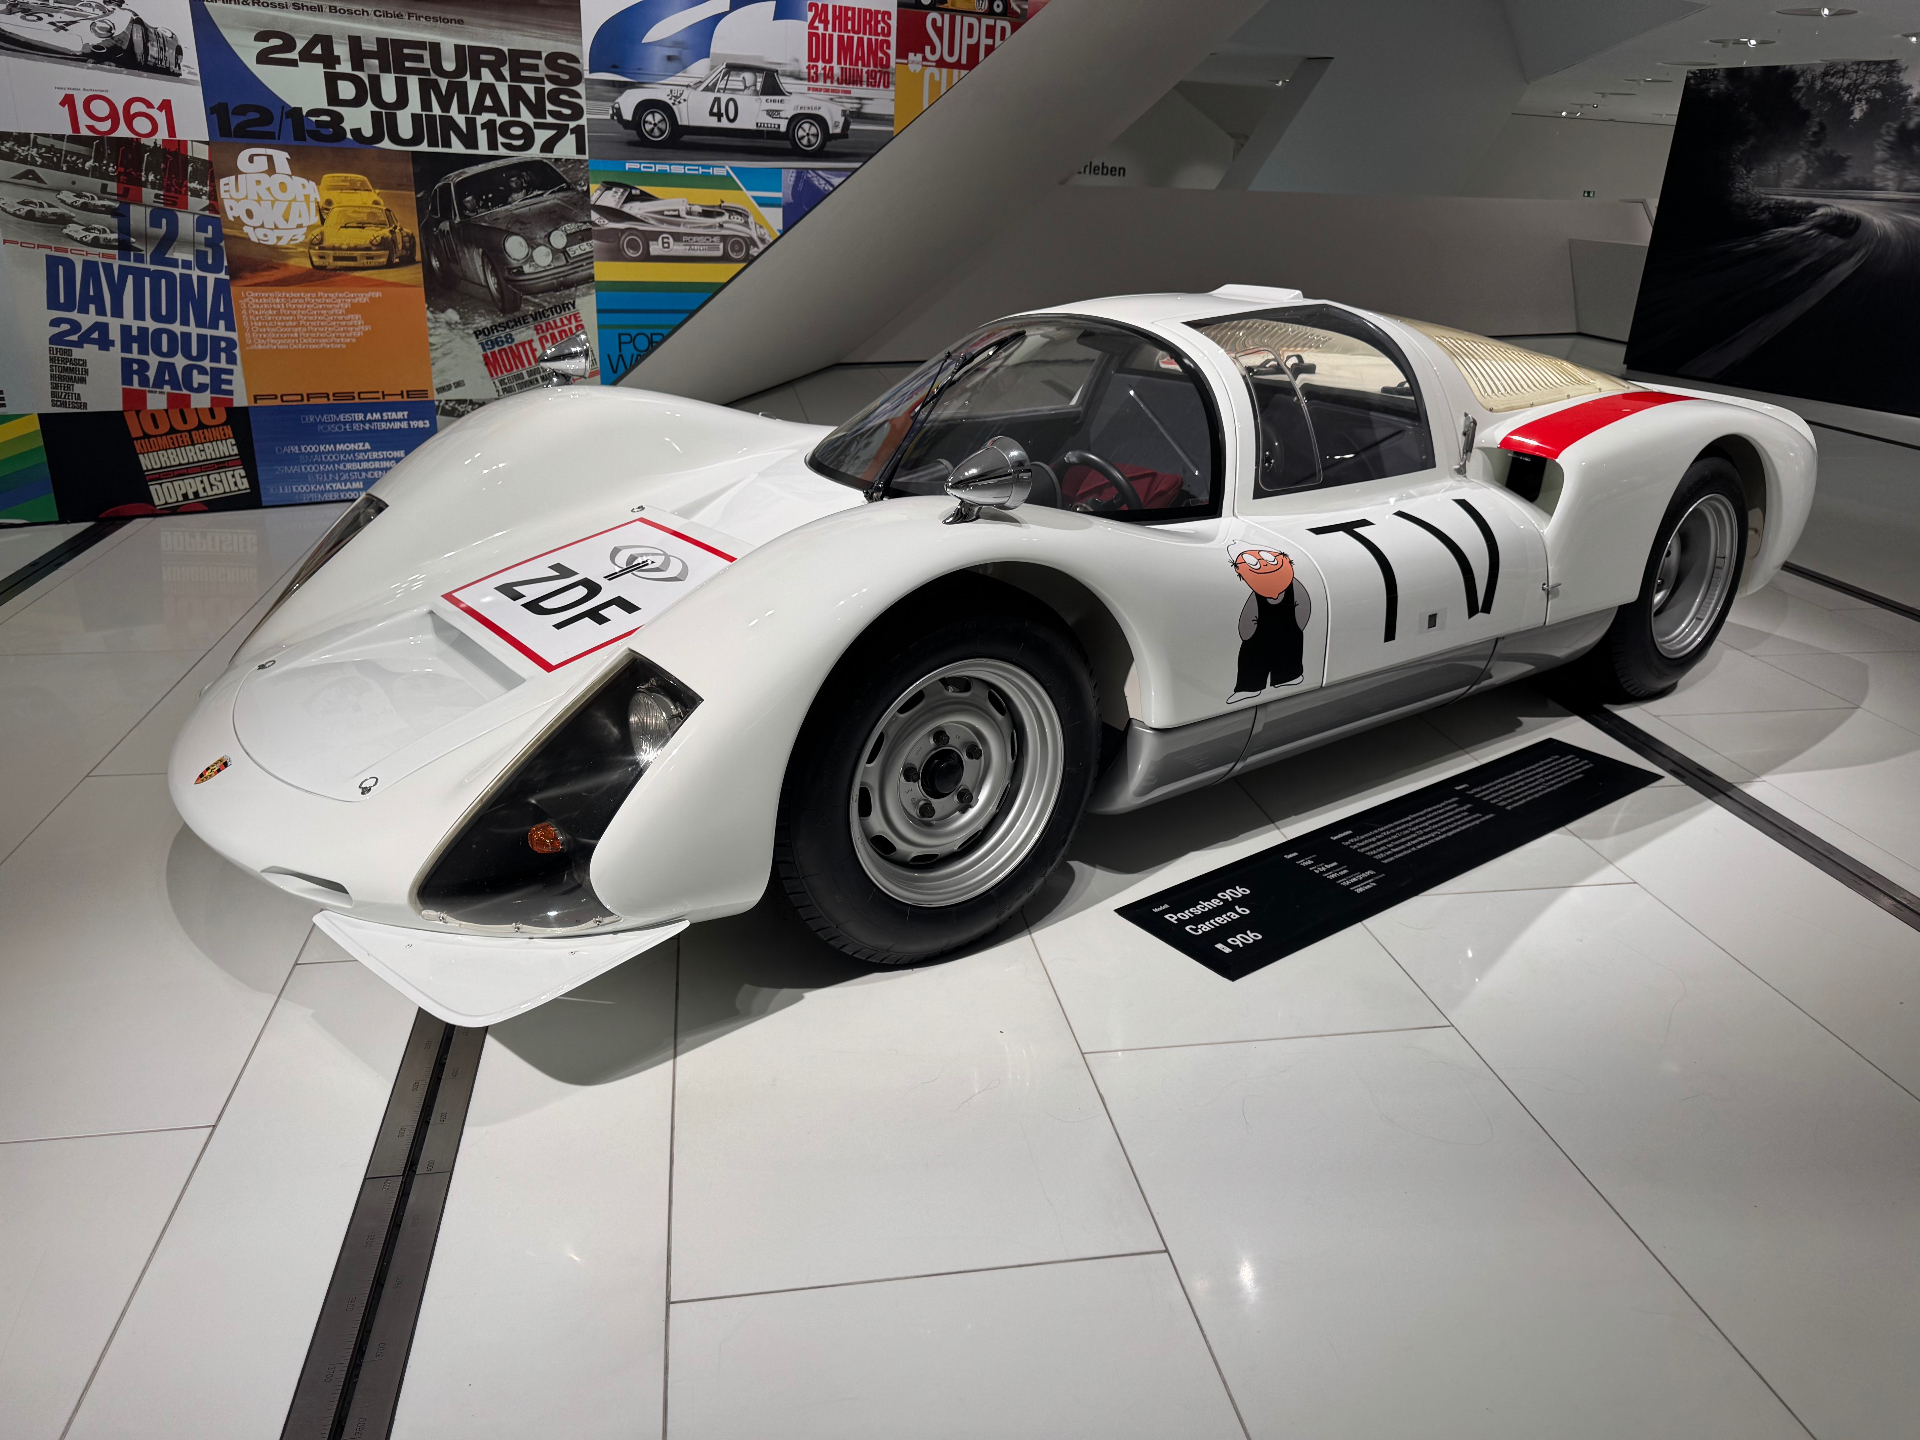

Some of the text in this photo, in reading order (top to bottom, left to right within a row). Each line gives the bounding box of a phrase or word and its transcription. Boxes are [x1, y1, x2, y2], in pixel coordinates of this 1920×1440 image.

[807, 2, 892, 39] 24 HEURES
[253, 30, 583, 88] 24 HEURES
[807, 31, 891, 70] DU MANS
[836, 67, 866, 87] JUIN
[865, 69, 891, 90] 1970
[324, 71, 585, 122] DU MANS
[709, 97, 739, 123] 40
[58, 93, 177, 139] 1961
[209, 102, 587, 155] 12/13 JUIN 1971
[237, 147, 292, 175] GT
[625, 162, 727, 175] PORSCHE
[1077, 161, 1126, 177] rleben
[219, 173, 320, 202] EUROPA
[223, 198, 319, 229] POKAL
[3, 239, 117, 260] PORSCHE
[243, 226, 307, 245] 1973
[661, 236, 671, 249] 6
[45, 254, 237, 333] DAYTONA
[473, 300, 578, 340] PORSCHE VICTORY
[534, 312, 583, 336] RALLYE
[48, 317, 238, 366] 24 HOUR
[478, 332, 515, 353] 1968
[121, 356, 234, 396] RACE
[253, 389, 429, 404] PORSCHE
[123, 407, 227, 438] 1000
[366, 412, 381, 420] AM
[382, 411, 409, 420] START
[409, 420, 430, 429] 1983
[133, 425, 234, 454] KILOMETER RENNEN
[320, 444, 335, 452] KM
[335, 442, 371, 451] MONZA
[149, 469, 250, 506] DOPPELSIEG
[325, 481, 364, 491] KYALAMI
[493, 562, 642, 630] ZDF
[1164, 885, 1251, 924] Porsche 906
[1184, 905, 1251, 936] Carrera 6
[1227, 930, 1263, 949] 906
